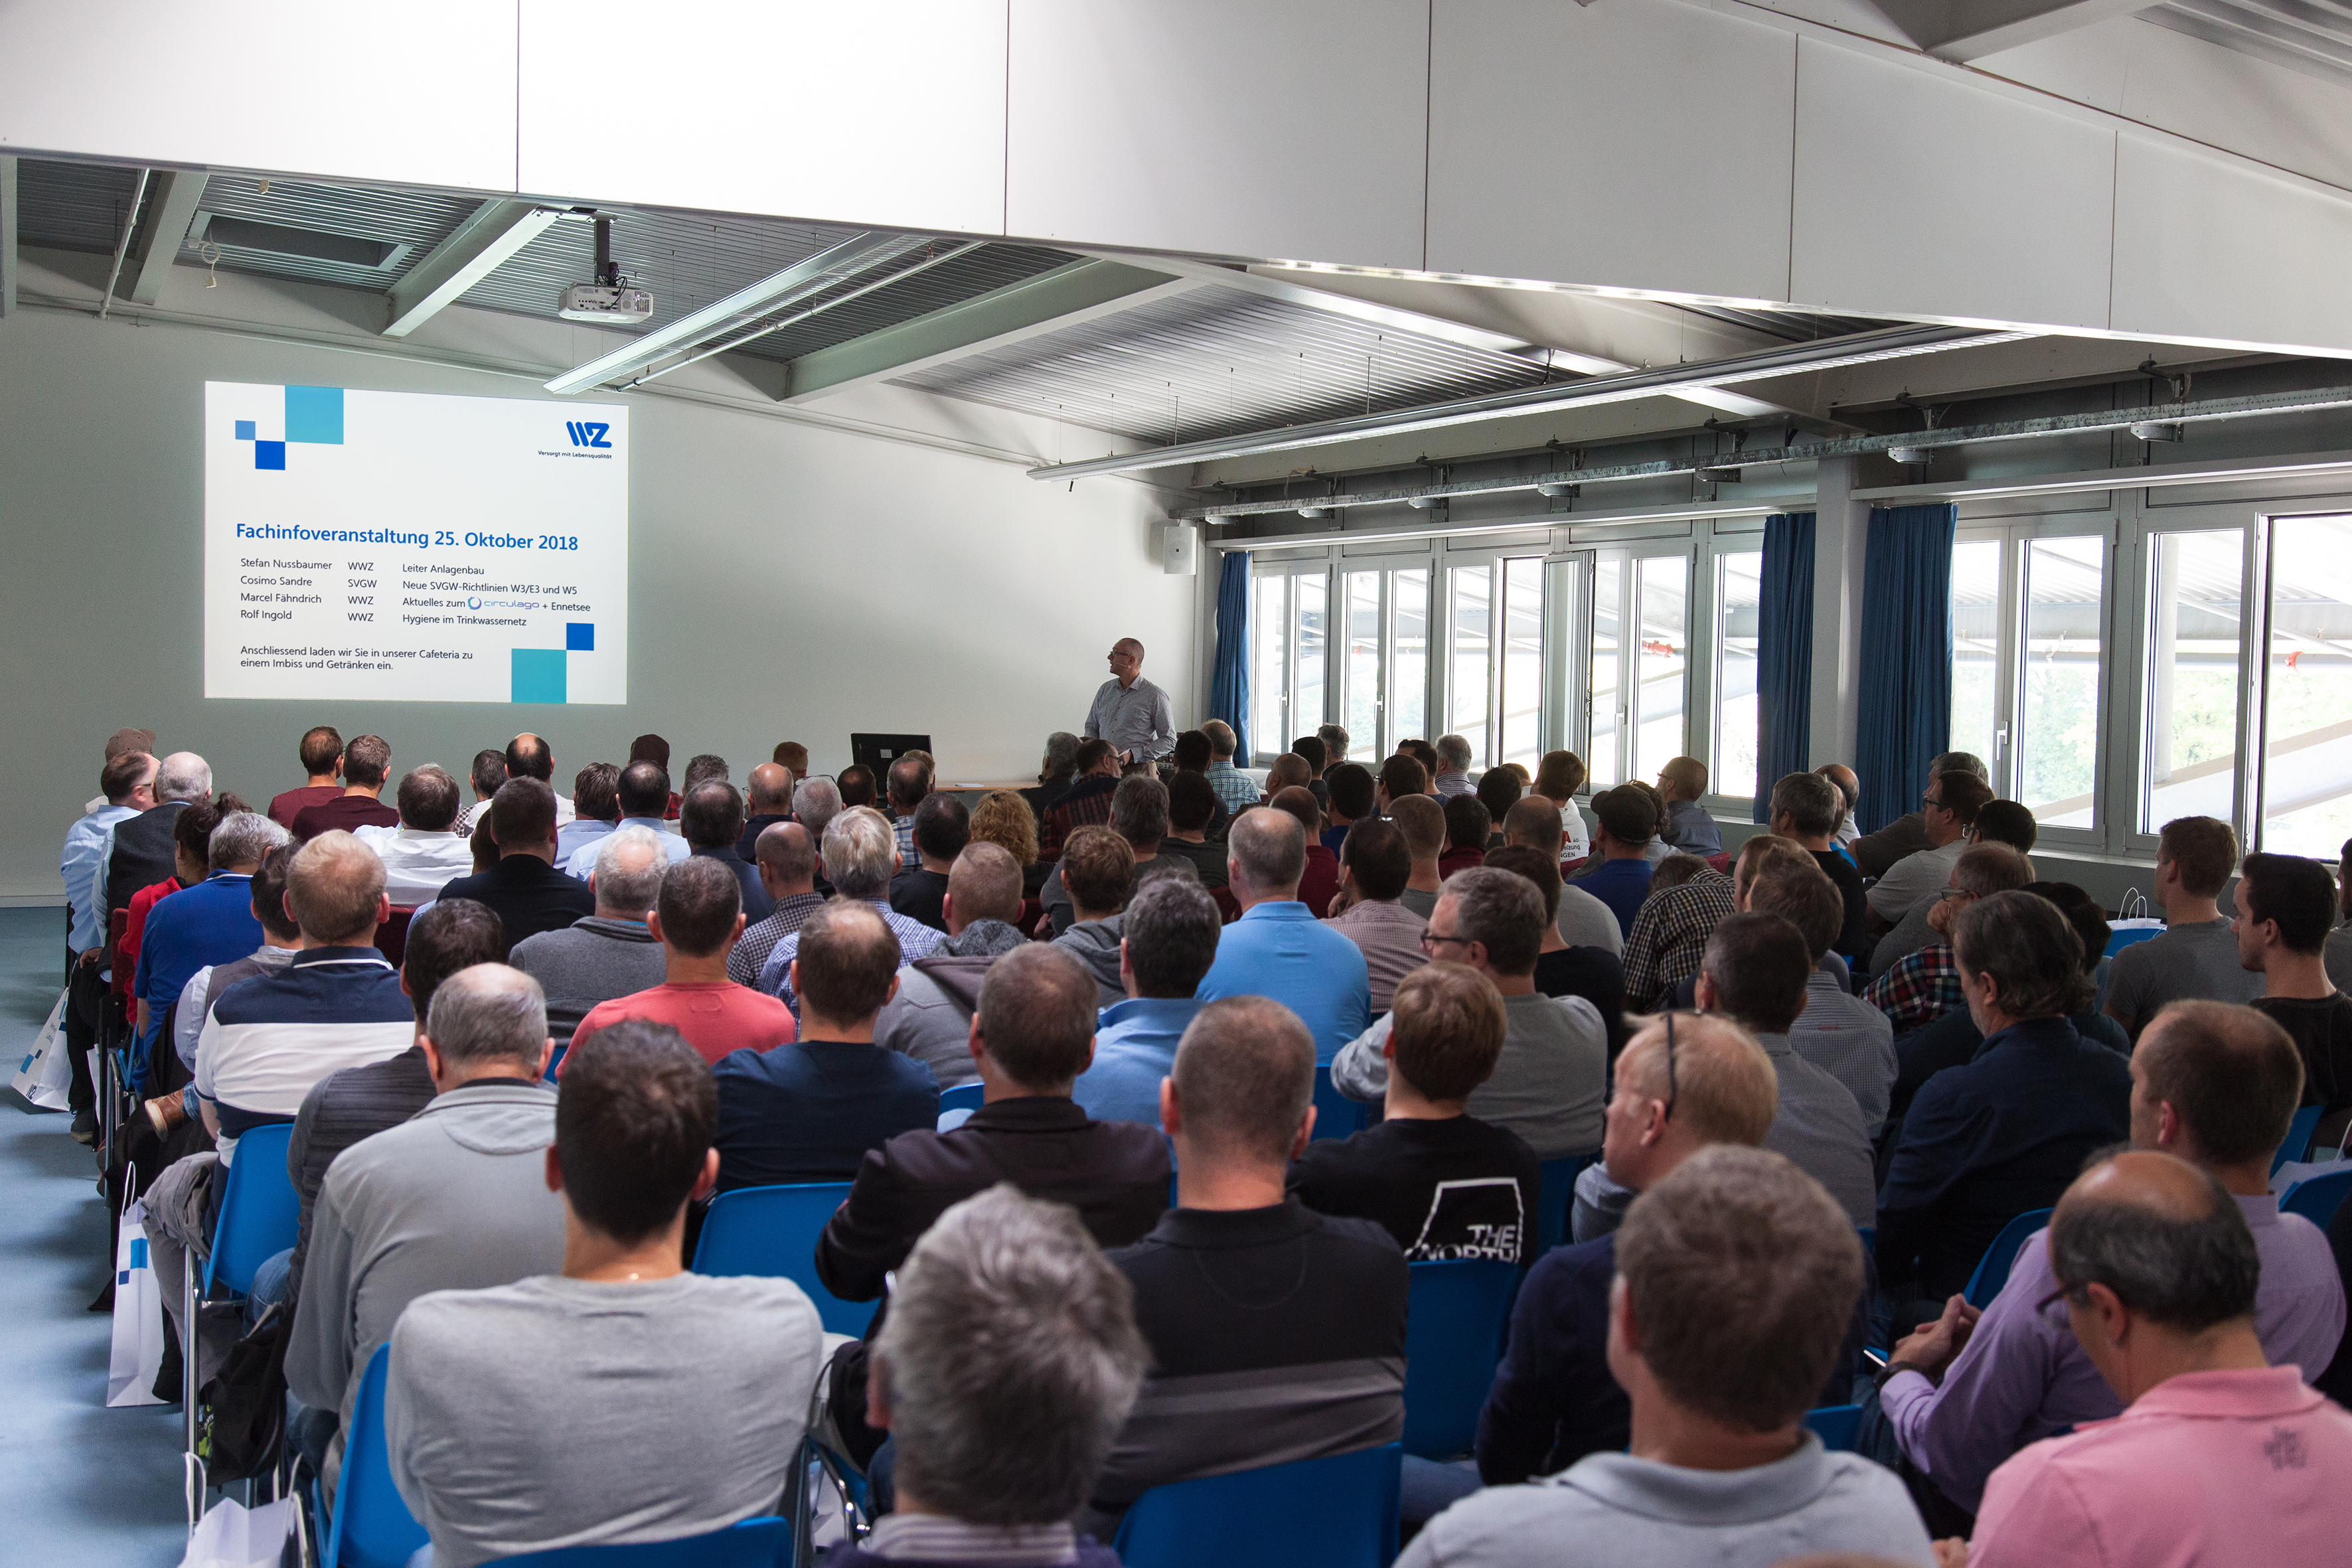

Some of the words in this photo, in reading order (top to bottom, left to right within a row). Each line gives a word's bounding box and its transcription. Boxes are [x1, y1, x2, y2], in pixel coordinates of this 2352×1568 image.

[236, 523, 429, 549] Fachinfoveranstaltung
[434, 530, 459, 546] 25.
[465, 532, 534, 549] Oktober
[538, 535, 578, 551] 2018
[240, 558, 270, 568] Stefan
[273, 559, 333, 570] Nussbaumer
[347, 562, 374, 572] WWZ
[402, 564, 428, 573] Leiter
[430, 564, 485, 576] Anlagenbau
[240, 575, 277, 586] Cosimo
[279, 576, 313, 586] Sandre
[348, 578, 377, 588] SVGW
[403, 580, 428, 590] Neue
[430, 581, 509, 592] SVGW-Richtlinien
[510, 584, 540, 594] W3/E3
[542, 585, 560, 594] und
[562, 586, 578, 595] W5
[240, 592, 273, 602] Marcel
[275, 593, 322, 603] Fähndrich
[347, 595, 374, 605] WWZ
[402, 597, 444, 607] Aktuelles
[483, 599, 540, 610] circulago
[551, 601, 591, 612] Ennetsee
[240, 609, 260, 619] Rolf
[262, 610, 292, 622] Ingold
[347, 612, 374, 622] WWZ
[402, 614, 440, 625] Hygiene
[443, 615, 454, 624] im
[456, 615, 527, 626] Trinkwassernetz
[240, 645, 307, 656] Anschliessend
[309, 647, 336, 657] laden
[338, 647, 353, 657] wir
[354, 648, 368, 657] Sie
[371, 648, 380, 657] in
[419, 649, 460, 659] Cafeteria
[240, 658, 270, 667] einem
[273, 659, 303, 668] Imbiss
[305, 659, 324, 668] und
[326, 660, 374, 670] Getränken
[376, 661, 394, 670] ein.
[1466, 1223, 1517, 1249] THE
